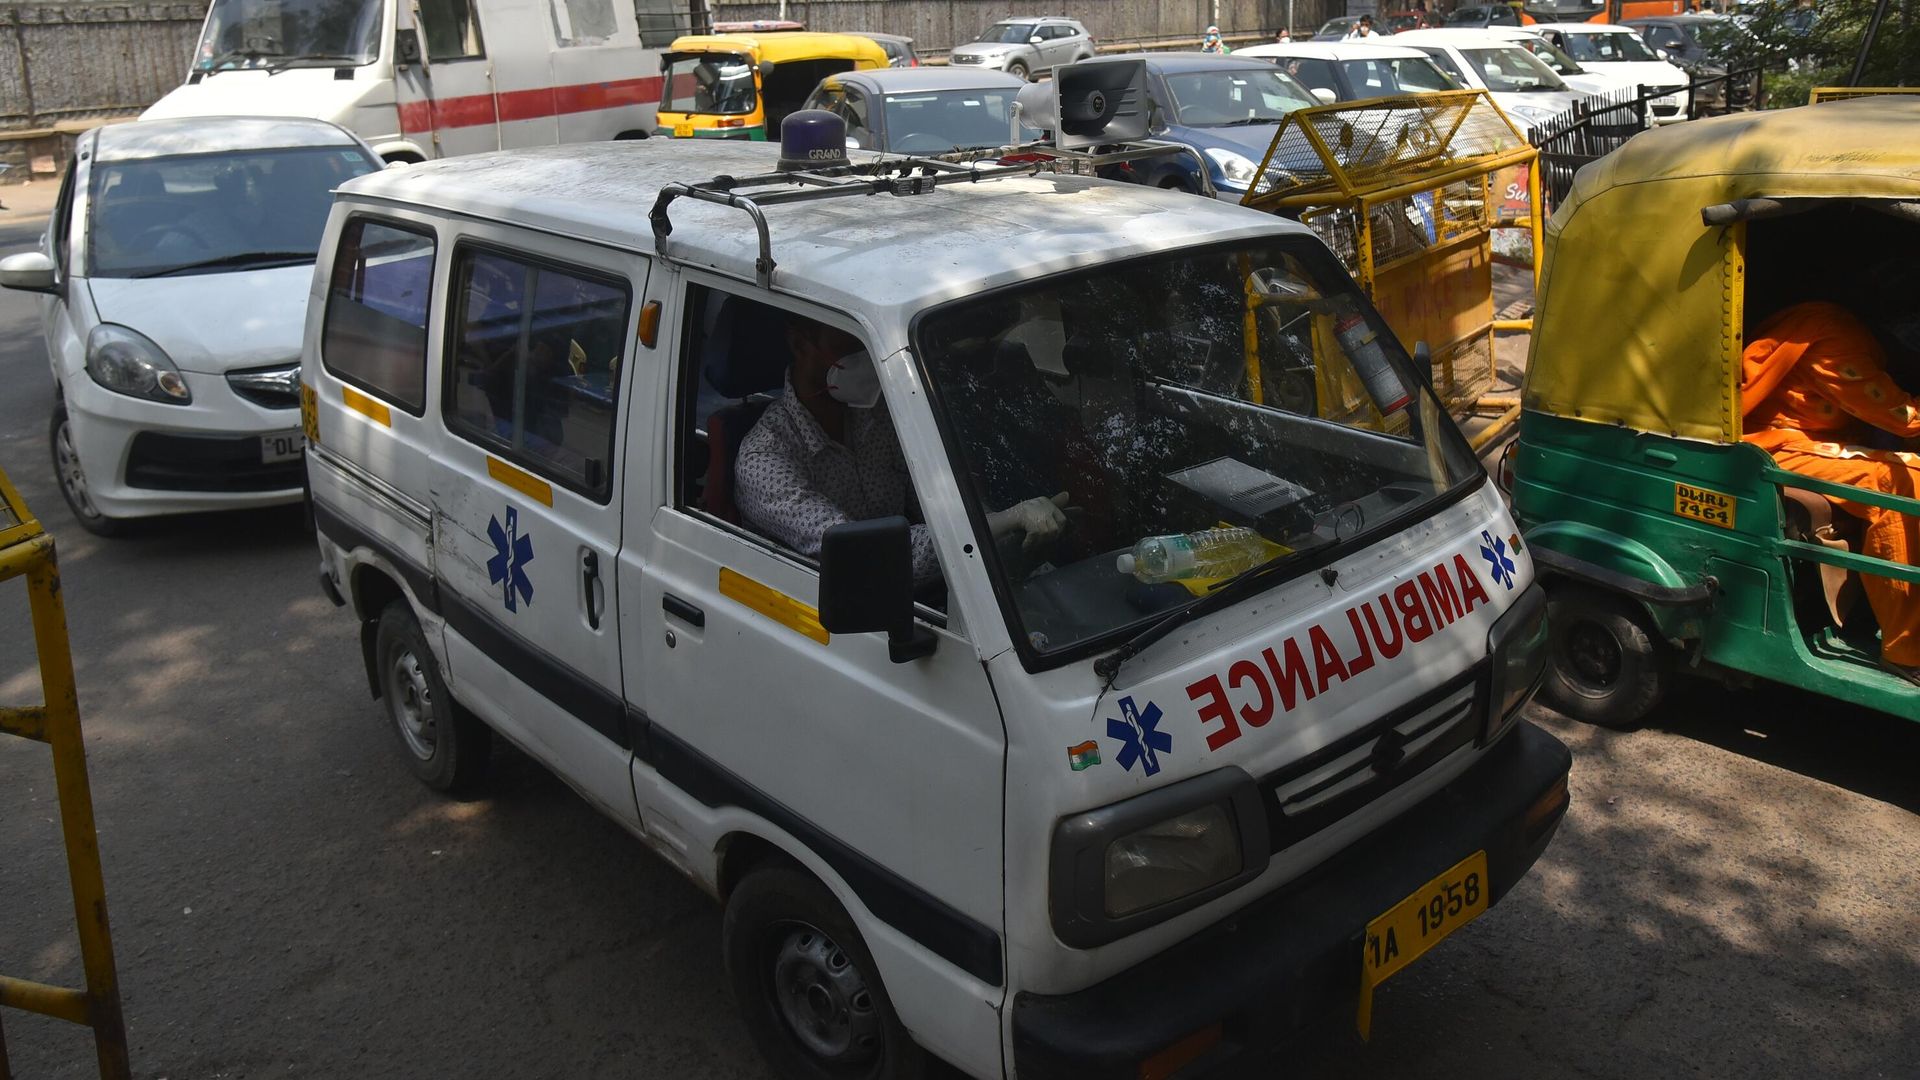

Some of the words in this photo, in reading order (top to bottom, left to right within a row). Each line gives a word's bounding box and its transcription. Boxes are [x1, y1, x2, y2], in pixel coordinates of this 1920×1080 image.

[808, 148, 841, 160] GRAND
[1679, 501, 1729, 523] 7464
[1417, 872, 1480, 937] 1958
